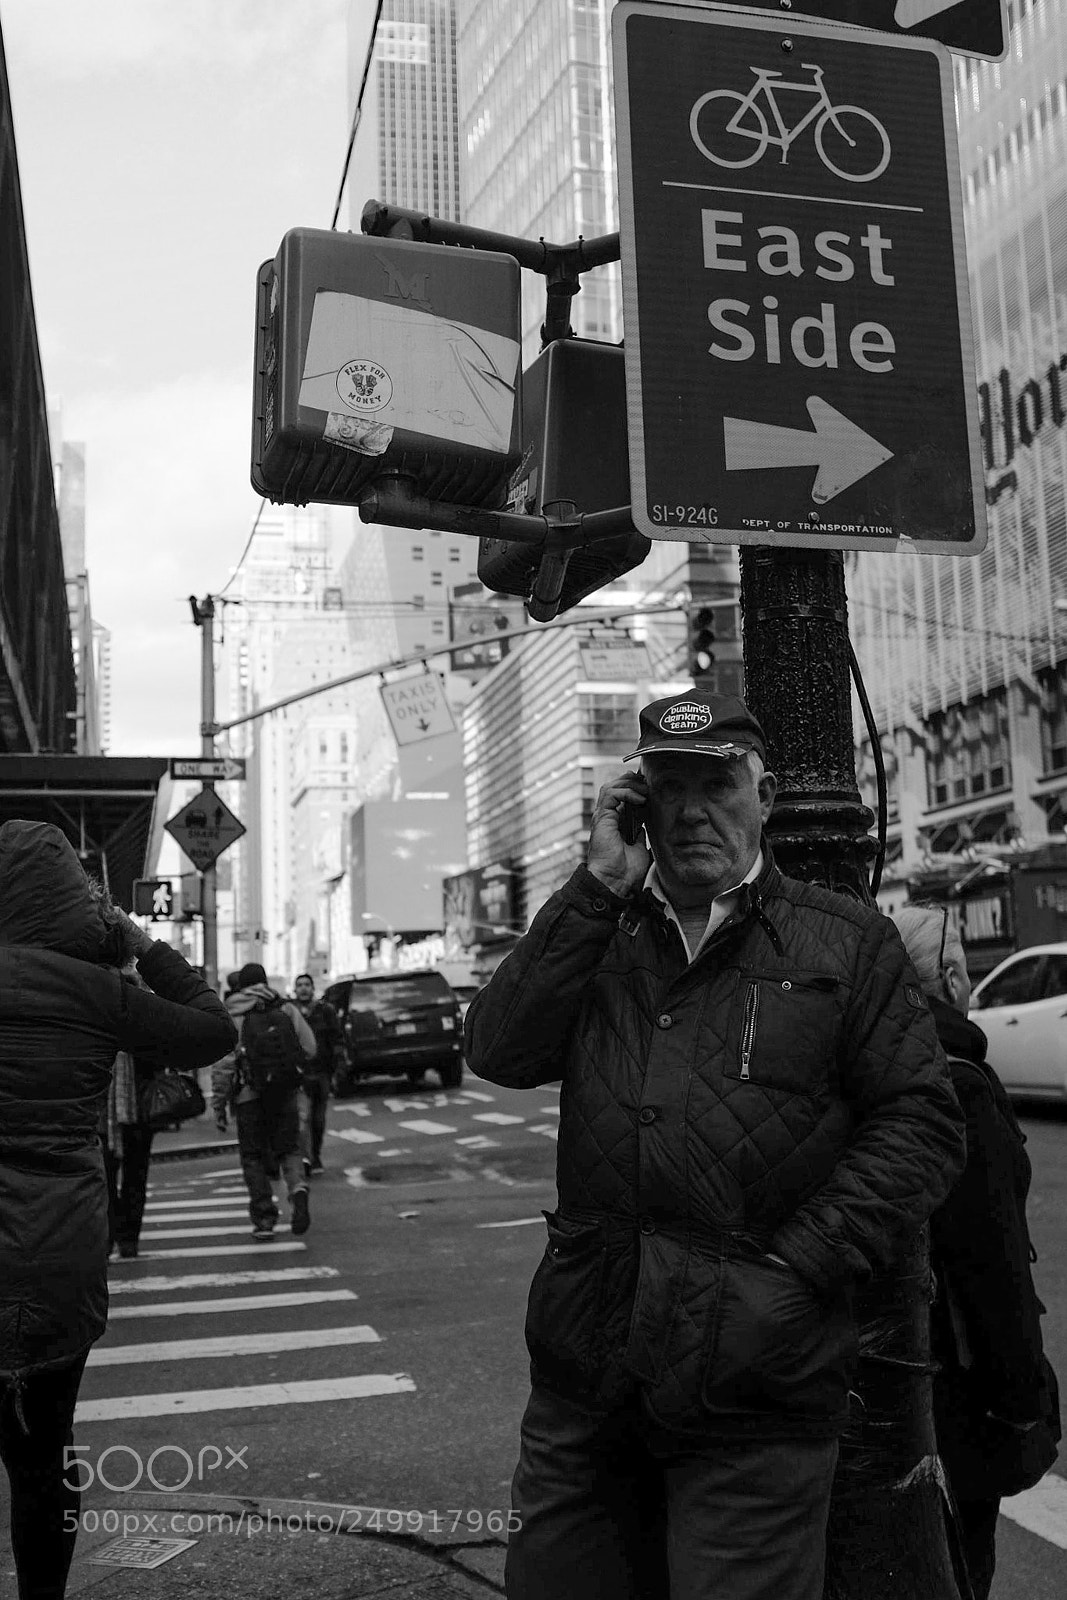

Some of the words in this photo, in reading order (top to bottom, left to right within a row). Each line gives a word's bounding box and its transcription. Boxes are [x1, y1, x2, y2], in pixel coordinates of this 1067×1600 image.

[700, 208, 896, 287] East
[707, 296, 897, 374] Side
[345, 365, 367, 375] FLEX
[370, 366, 385, 379] FOR
[348, 392, 381, 404] MONEY
[652, 505, 719, 525] SI-924G
[777, 521, 791, 529] OF
[797, 522, 893, 535] TRANSPORTATION
[390, 681, 436, 705] TAXIS
[396, 698, 438, 720] ONLY
[670, 721, 698, 730] team
[180, 764, 202, 776] ONE
[212, 764, 235, 775] WAY
